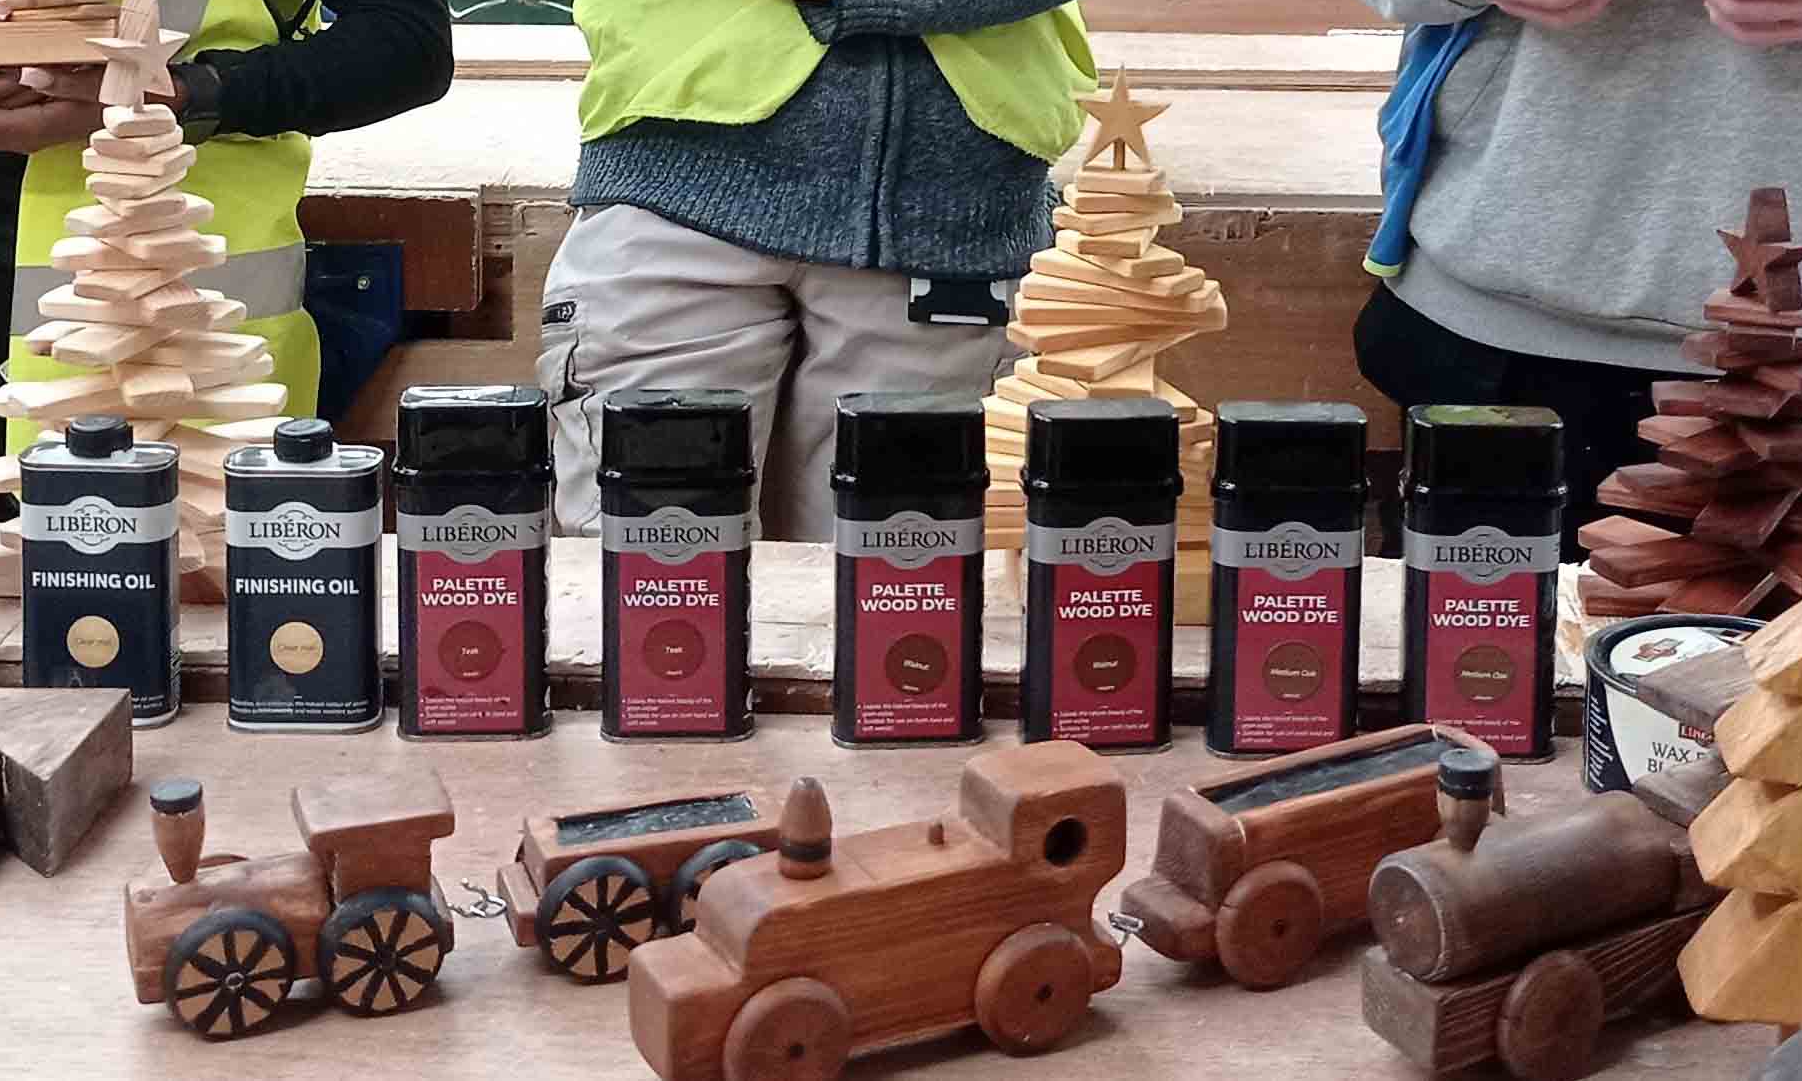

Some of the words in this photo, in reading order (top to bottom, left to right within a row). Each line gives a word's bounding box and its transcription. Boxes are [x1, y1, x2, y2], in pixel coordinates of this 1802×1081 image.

[46, 513, 137, 534] LIBÉRON
[249, 519, 341, 540] LIBÉRON
[421, 523, 518, 543] LIBÉRON
[624, 525, 720, 544] LIBÉRON
[862, 528, 957, 550] LIBÉRON
[1061, 534, 1155, 555] LIBÉRON
[1244, 540, 1340, 561] LIBÉRON
[1435, 544, 1533, 565] LIBÉRON
[32, 571, 122, 589] FINISHING
[124, 574, 156, 590] OIL
[235, 578, 325, 595] FINISHING
[328, 579, 360, 595] OIL
[432, 578, 507, 592] PALETTE
[635, 580, 708, 593] PALETTE
[872, 584, 945, 598] PALETTE
[1070, 589, 1143, 604] PALETTE
[421, 592, 479, 606] WOOD
[483, 592, 518, 605] DYE
[623, 594, 681, 607] WOOD
[685, 594, 719, 607] DYE
[861, 599, 918, 612] WOOD
[922, 598, 956, 611] DYE
[1254, 595, 1327, 608] PALETTE
[1445, 599, 1519, 613] PALETTE
[1059, 605, 1115, 619] WOOD
[1119, 604, 1153, 617] DYE
[1243, 610, 1300, 623] WOOD
[1304, 610, 1338, 623] DYE
[1433, 614, 1492, 627] WOOD
[1495, 614, 1531, 628] DYE
[1652, 742, 1692, 762] WAX
